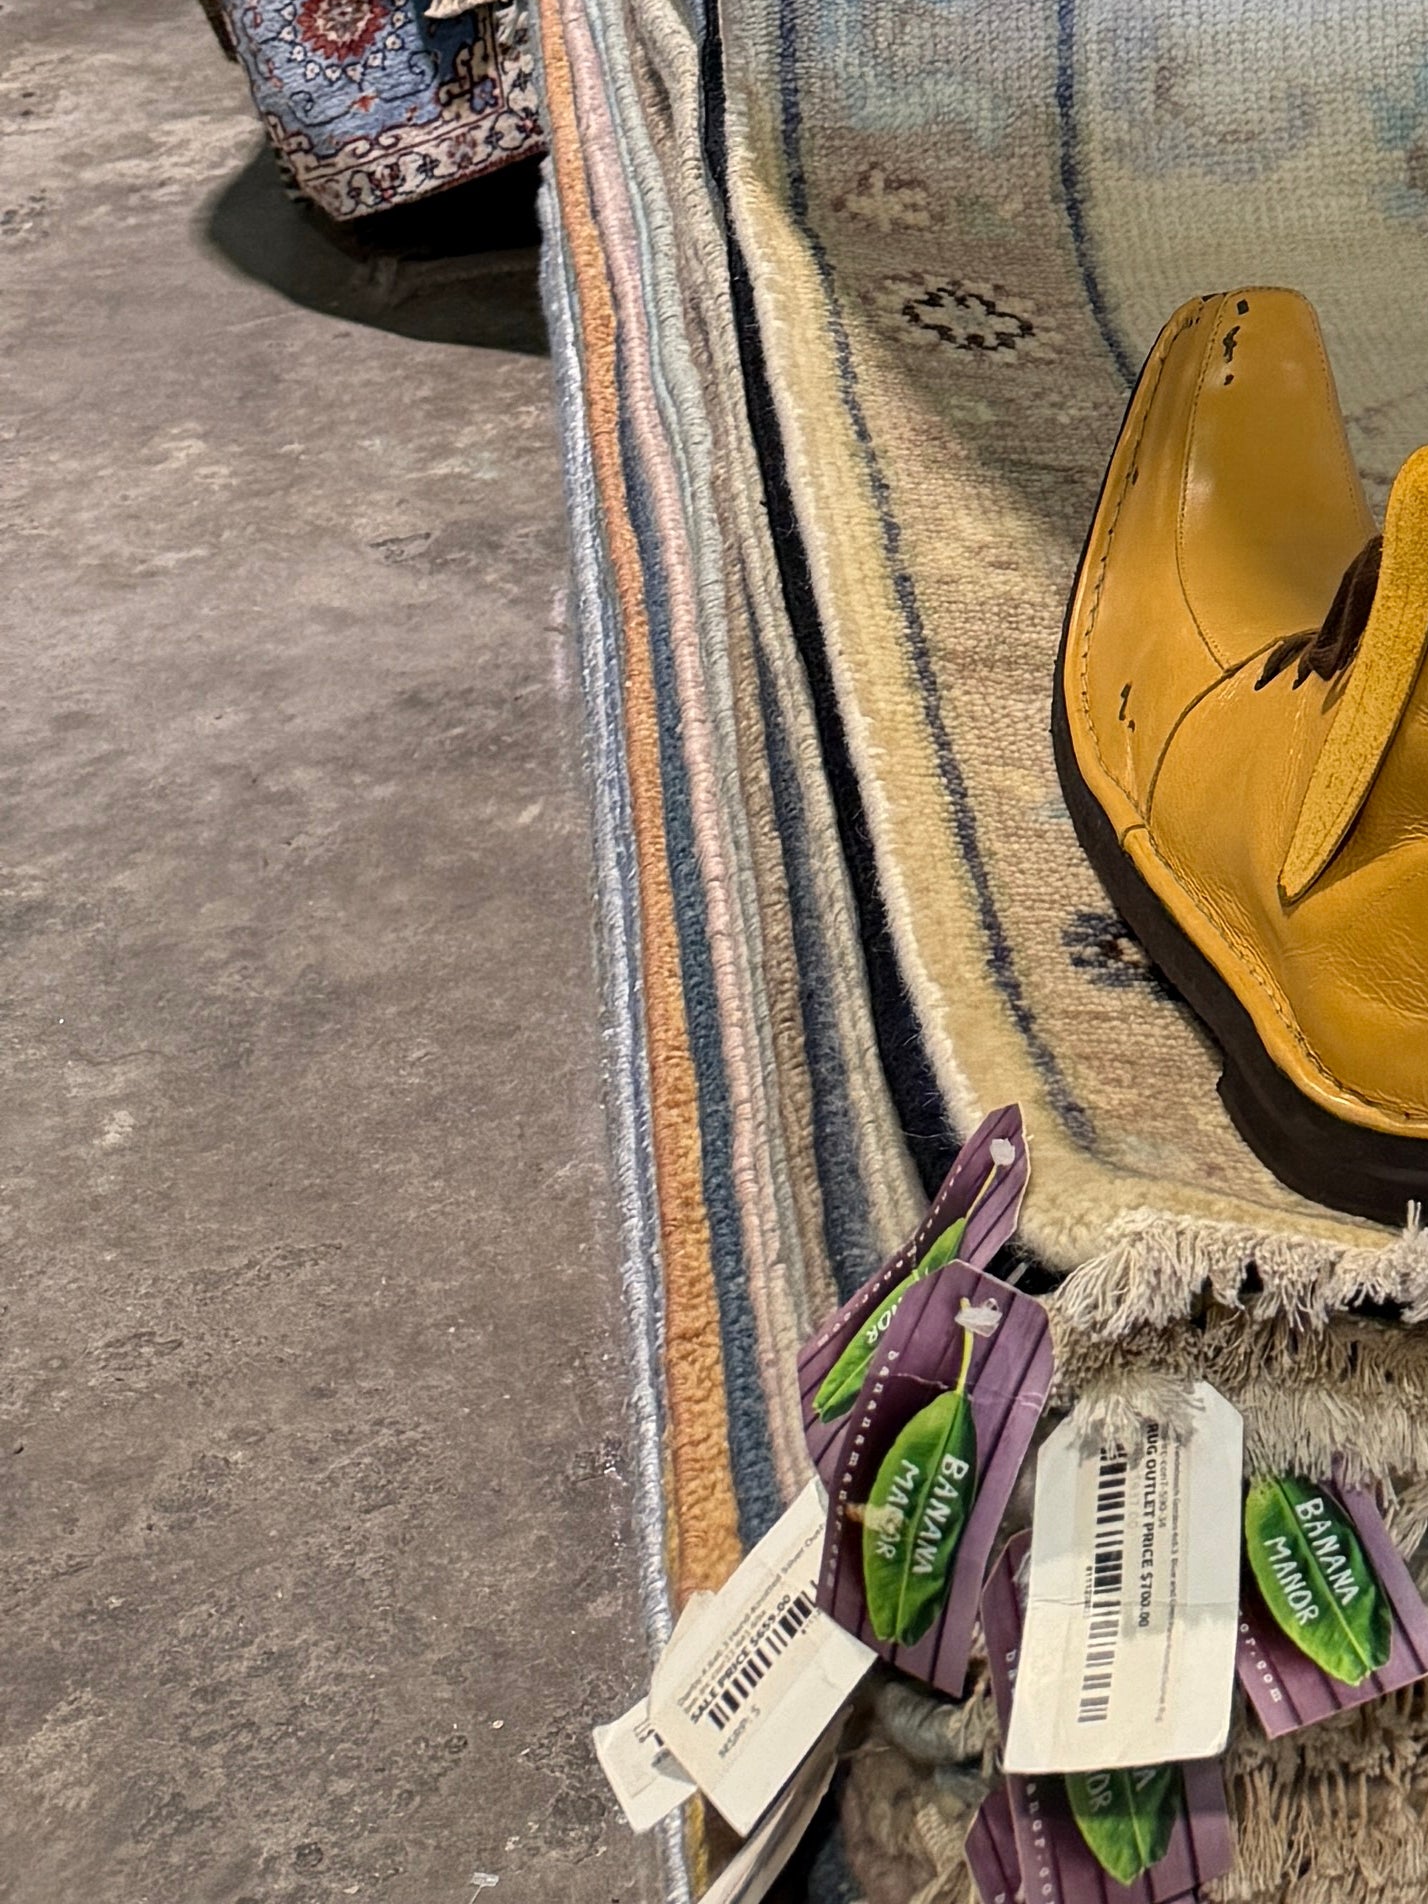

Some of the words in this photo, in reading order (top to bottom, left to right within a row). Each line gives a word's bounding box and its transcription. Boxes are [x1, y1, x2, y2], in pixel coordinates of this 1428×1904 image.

[1146, 1423, 1160, 1456] RUG
[911, 1453, 970, 1574] BANANA
[1143, 1458, 1157, 1518] OUTLET
[1142, 1521, 1155, 1568] PRICE
[1294, 1497, 1361, 1607] BANANA
[1137, 1572, 1154, 1628] $700.00
[1263, 1536, 1320, 1626] MANOR
[689, 1685, 719, 1725] SALE
[717, 1645, 751, 1689] PRICE
